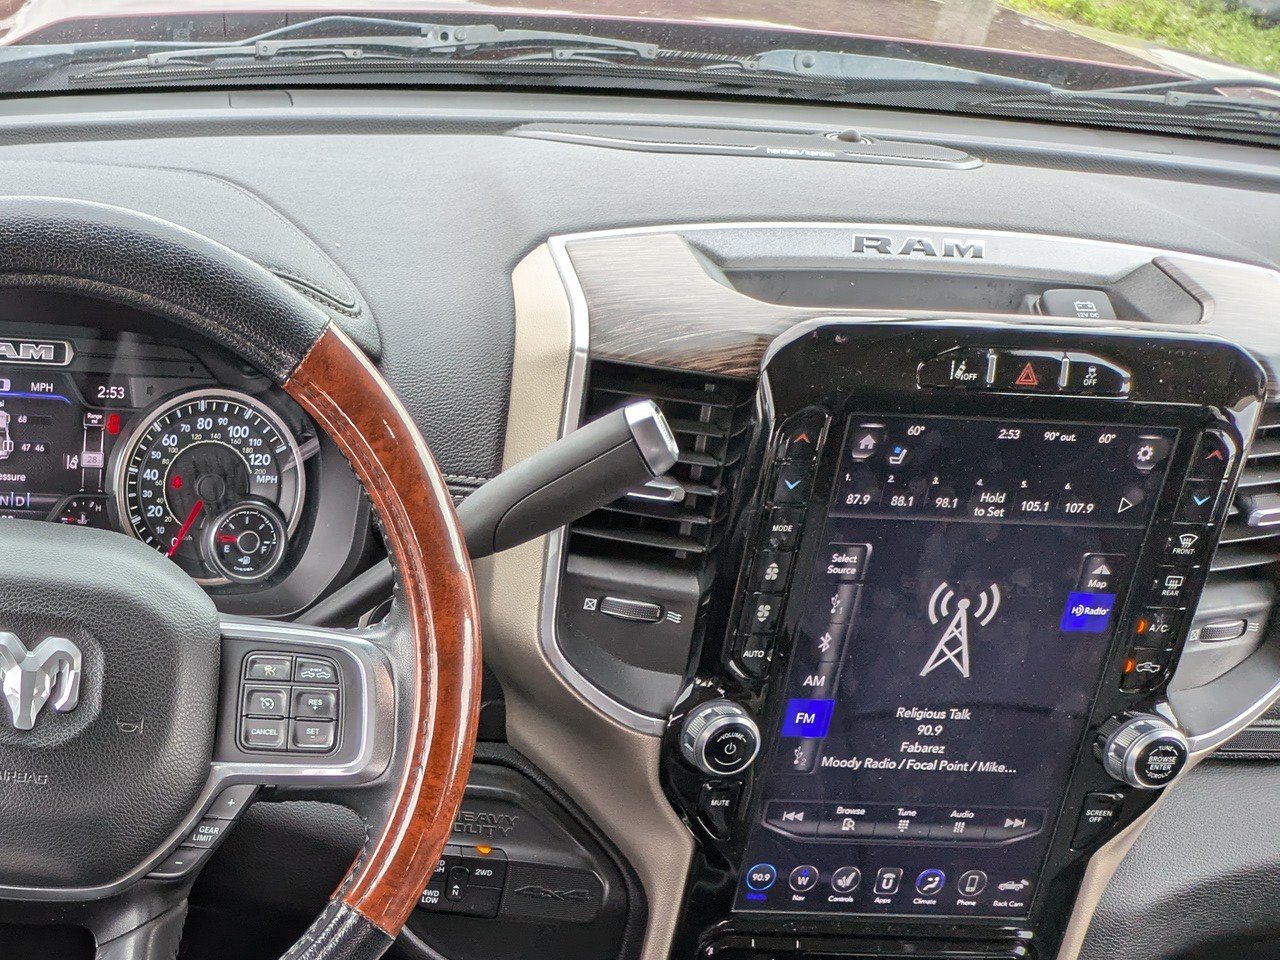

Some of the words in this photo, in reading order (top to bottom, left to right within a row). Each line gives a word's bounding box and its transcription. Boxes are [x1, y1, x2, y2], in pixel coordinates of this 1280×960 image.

[851, 233, 986, 259] RAM
[963, 373, 978, 381] OFF
[1083, 378, 1098, 386] OFF
[30, 382, 54, 392] MPH
[97, 386, 125, 399] 2:53
[18, 415, 28, 423] 68
[196, 417, 213, 430] 80
[217, 417, 229, 426] 90
[180, 424, 191, 433] 70
[227, 425, 250, 438] 100
[998, 429, 1020, 439] 2:53
[162, 434, 178, 447] 60
[248, 437, 263, 446] 110
[150, 450, 162, 459] 50
[248, 453, 271, 466] 120
[142, 468, 159, 481] 40
[256, 475, 278, 484] MPH
[142, 489, 153, 498] 30
[980, 492, 1006, 503] Hold
[846, 494, 870, 505] 87.9
[890, 496, 914, 506] 88.1
[935, 497, 958, 508] 98.1
[147, 505, 163, 517] 20
[1021, 501, 1049, 512] 105.1
[1065, 503, 1094, 514] 107.9
[974, 507, 985, 517] to
[986, 506, 1005, 517] Set
[155, 526, 165, 534] 10
[224, 545, 230, 553] E
[260, 546, 267, 554] F
[831, 554, 857, 563] Select
[827, 565, 857, 574] Source
[1087, 580, 1107, 589] Map
[1149, 624, 1169, 633] A/C
[743, 650, 765, 658] AUTO
[803, 675, 826, 686] AM
[795, 713, 816, 724] FM
[896, 707, 947, 721] Religious
[949, 709, 971, 721] Talk
[251, 728, 278, 736] CANCEL
[917, 725, 943, 736] 90.9
[720, 732, 744, 740] VOLUME
[900, 742, 946, 754] Fabarez
[821, 756, 862, 771] Moody
[863, 758, 897, 769] Radio
[906, 760, 937, 771] Focal
[939, 761, 968, 771] Point
[1147, 771, 1168, 779] SCROLL
[836, 806, 866, 816] Browse
[897, 808, 917, 817] Tune
[950, 810, 975, 819] Audio
[1086, 809, 1113, 817] SCREEN
[458, 811, 519, 826] EAVY
[199, 826, 220, 834] GEAR
[192, 834, 213, 842] LIMIT
[752, 873, 771, 882] 90.9
[422, 889, 440, 897] 4WD
[421, 896, 439, 904] LOW
[874, 897, 891, 905] Apps
[912, 898, 937, 906] Climate
[956, 899, 977, 907] Phone
[993, 900, 1008, 908] Back
